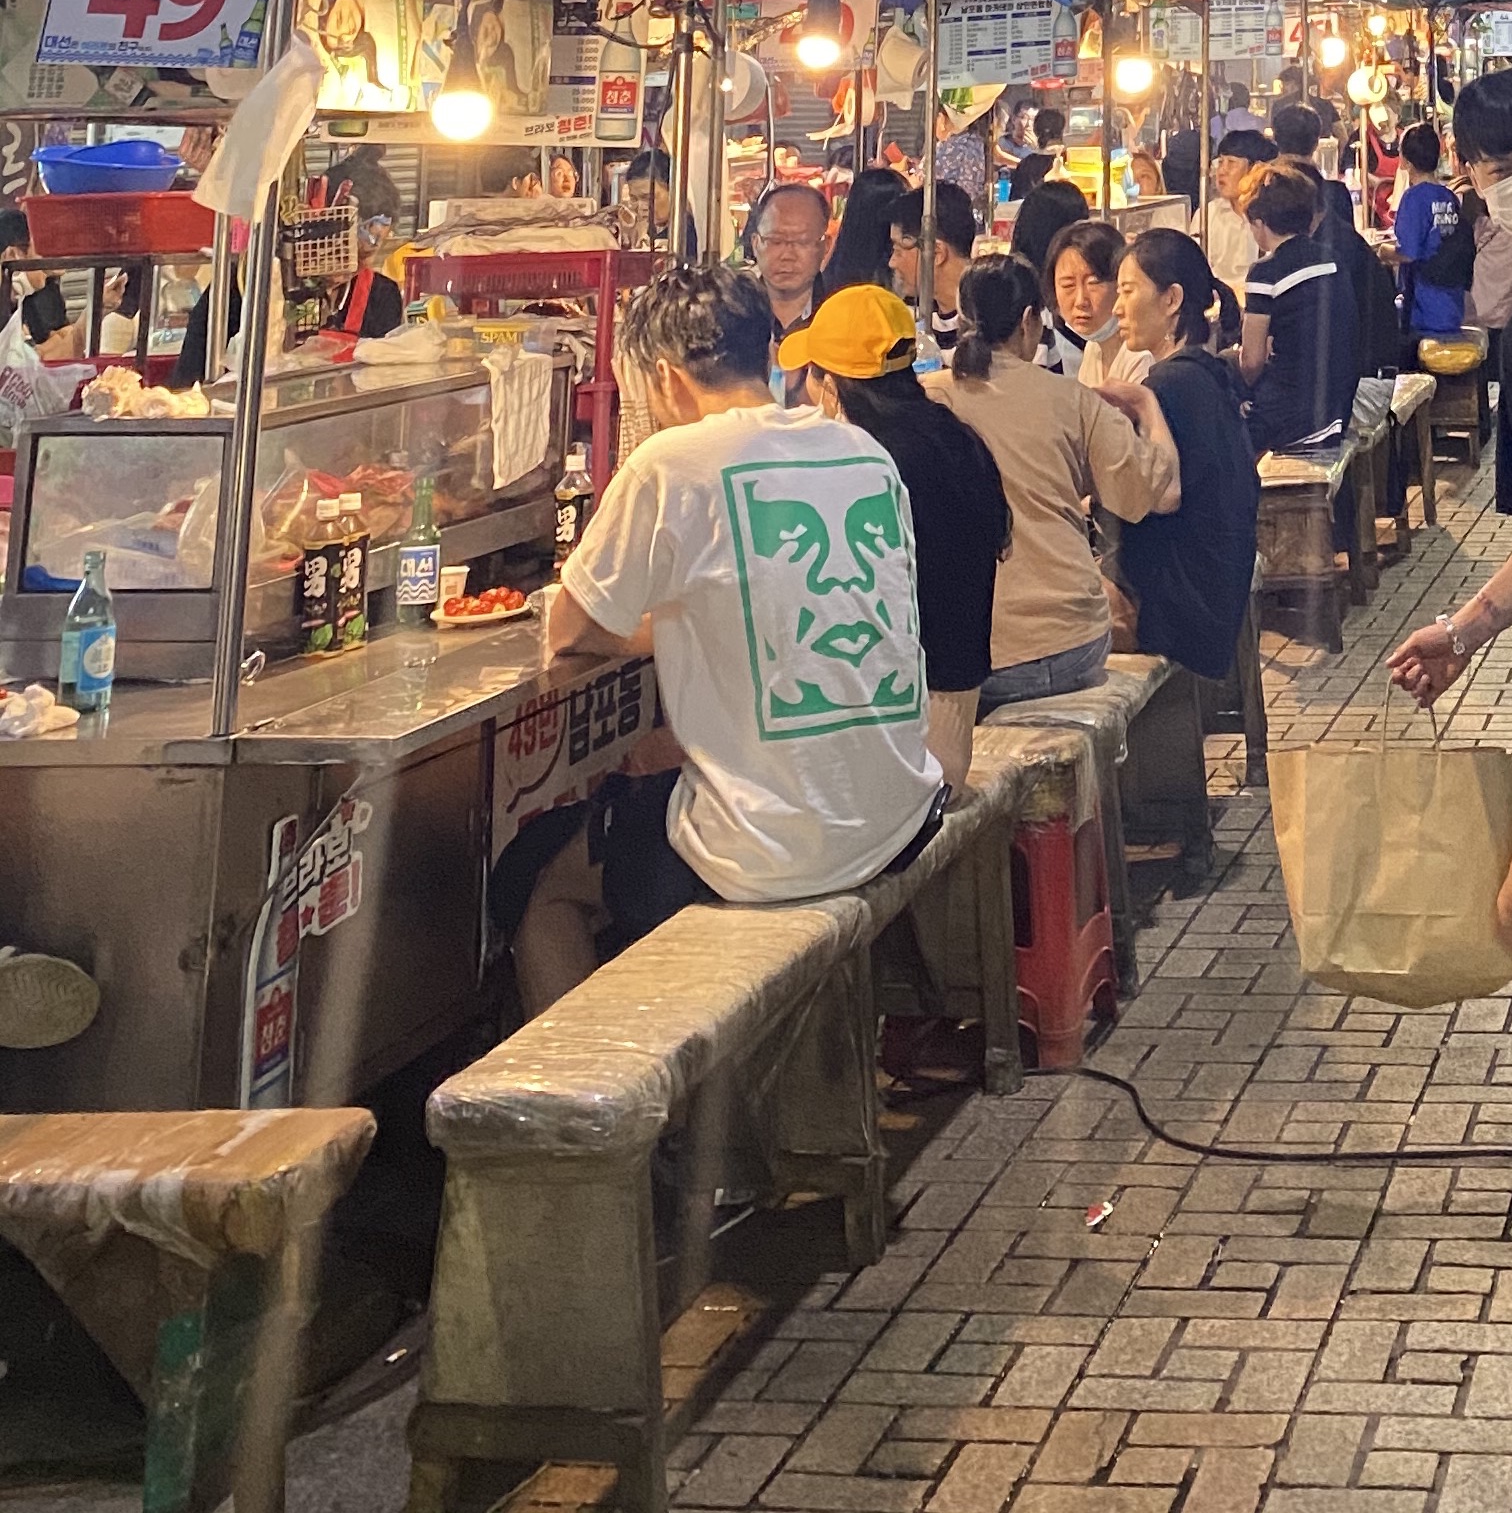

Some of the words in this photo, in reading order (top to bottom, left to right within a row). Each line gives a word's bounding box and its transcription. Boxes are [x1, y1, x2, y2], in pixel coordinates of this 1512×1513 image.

[605, 90, 633, 106] 청춘
[480, 330, 518, 345] SPAM
[303, 555, 328, 598] 男
